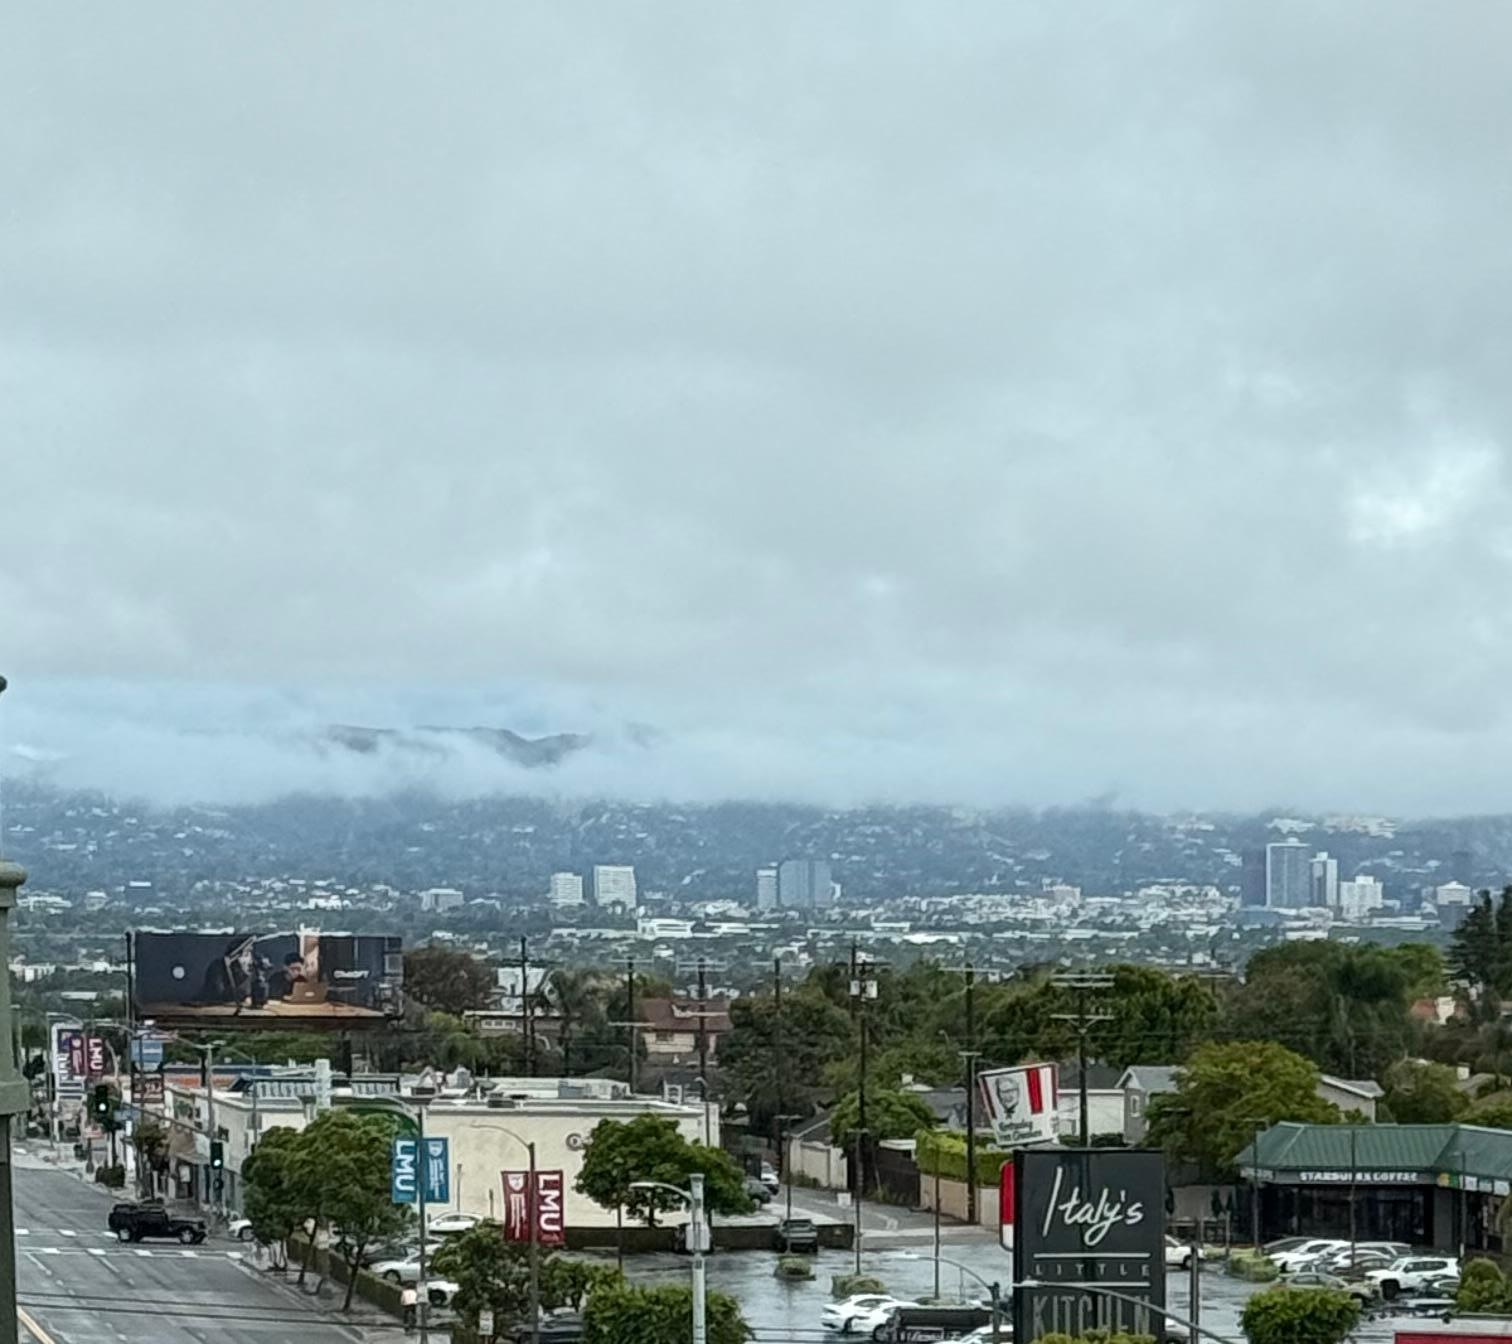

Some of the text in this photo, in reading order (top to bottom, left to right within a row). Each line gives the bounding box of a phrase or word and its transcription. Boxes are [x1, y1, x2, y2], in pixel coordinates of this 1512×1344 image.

[395, 1140, 415, 1192] LMU
[538, 1173, 561, 1232] LMU
[1042, 1165, 1144, 1247] Italy's
[1035, 1263, 1150, 1277] LITTLE
